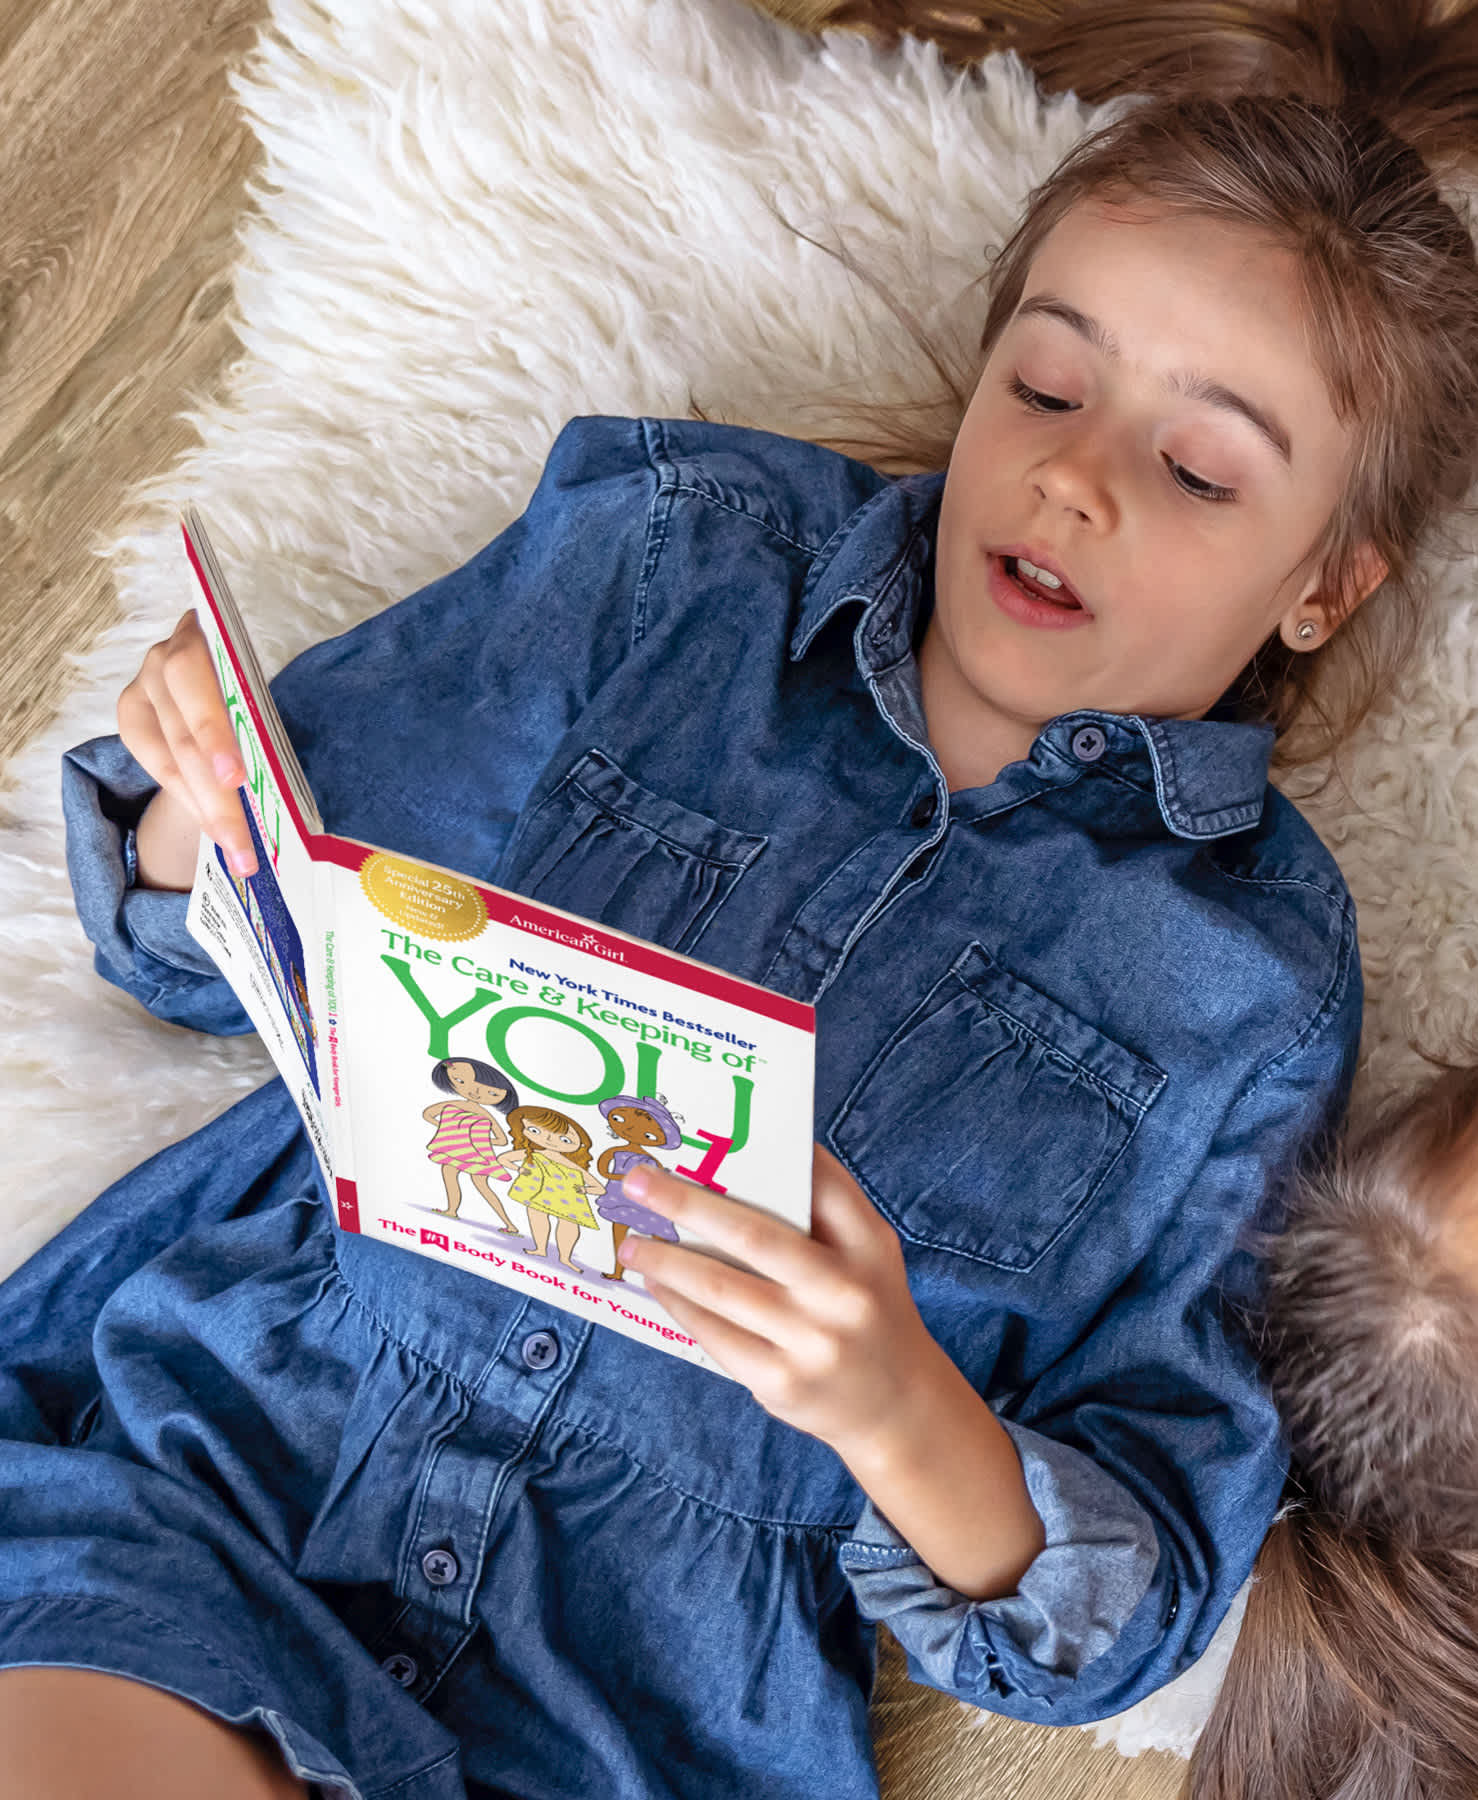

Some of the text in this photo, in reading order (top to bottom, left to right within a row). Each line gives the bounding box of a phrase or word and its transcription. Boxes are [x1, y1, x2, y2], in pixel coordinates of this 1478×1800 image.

[384, 875, 464, 911] Anniversary
[399, 890, 445, 913] Edition
[510, 912, 625, 962] American Girl
[381, 929, 755, 1072] The Care & Keeping of
[509, 958, 756, 1049] New York Times Bestseller
[377, 1218, 416, 1235] The
[454, 1242, 505, 1266] Body
[511, 1264, 565, 1289] Book
[572, 1287, 601, 1303] for
[607, 1300, 696, 1346] Younger
